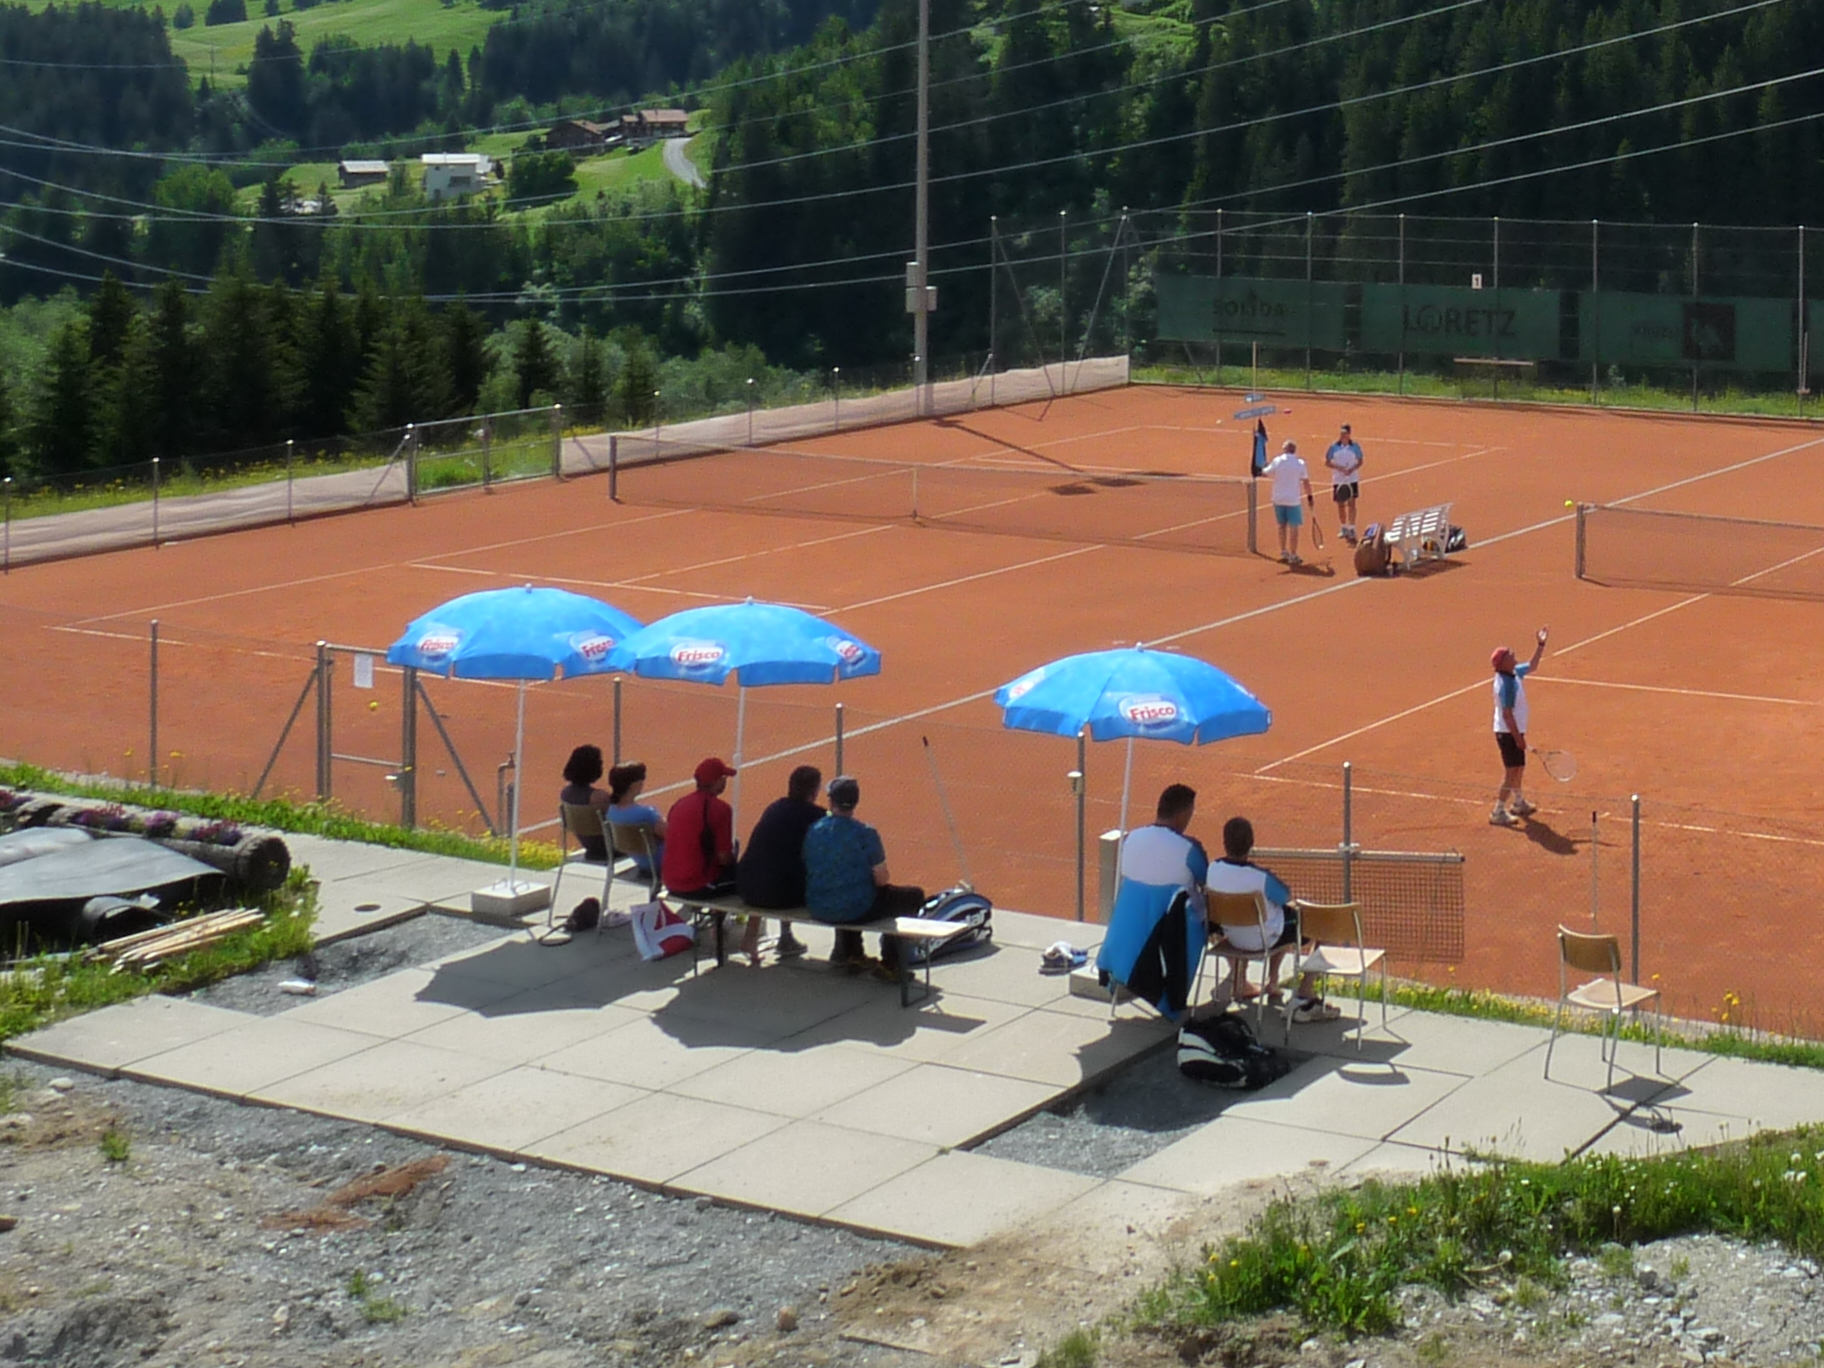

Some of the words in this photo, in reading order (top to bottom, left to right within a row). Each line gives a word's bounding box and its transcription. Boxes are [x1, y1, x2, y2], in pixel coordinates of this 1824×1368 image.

[1403, 304, 1517, 336] LORETZ
[677, 649, 720, 662] Frisco
[1130, 706, 1175, 721] Frisco
